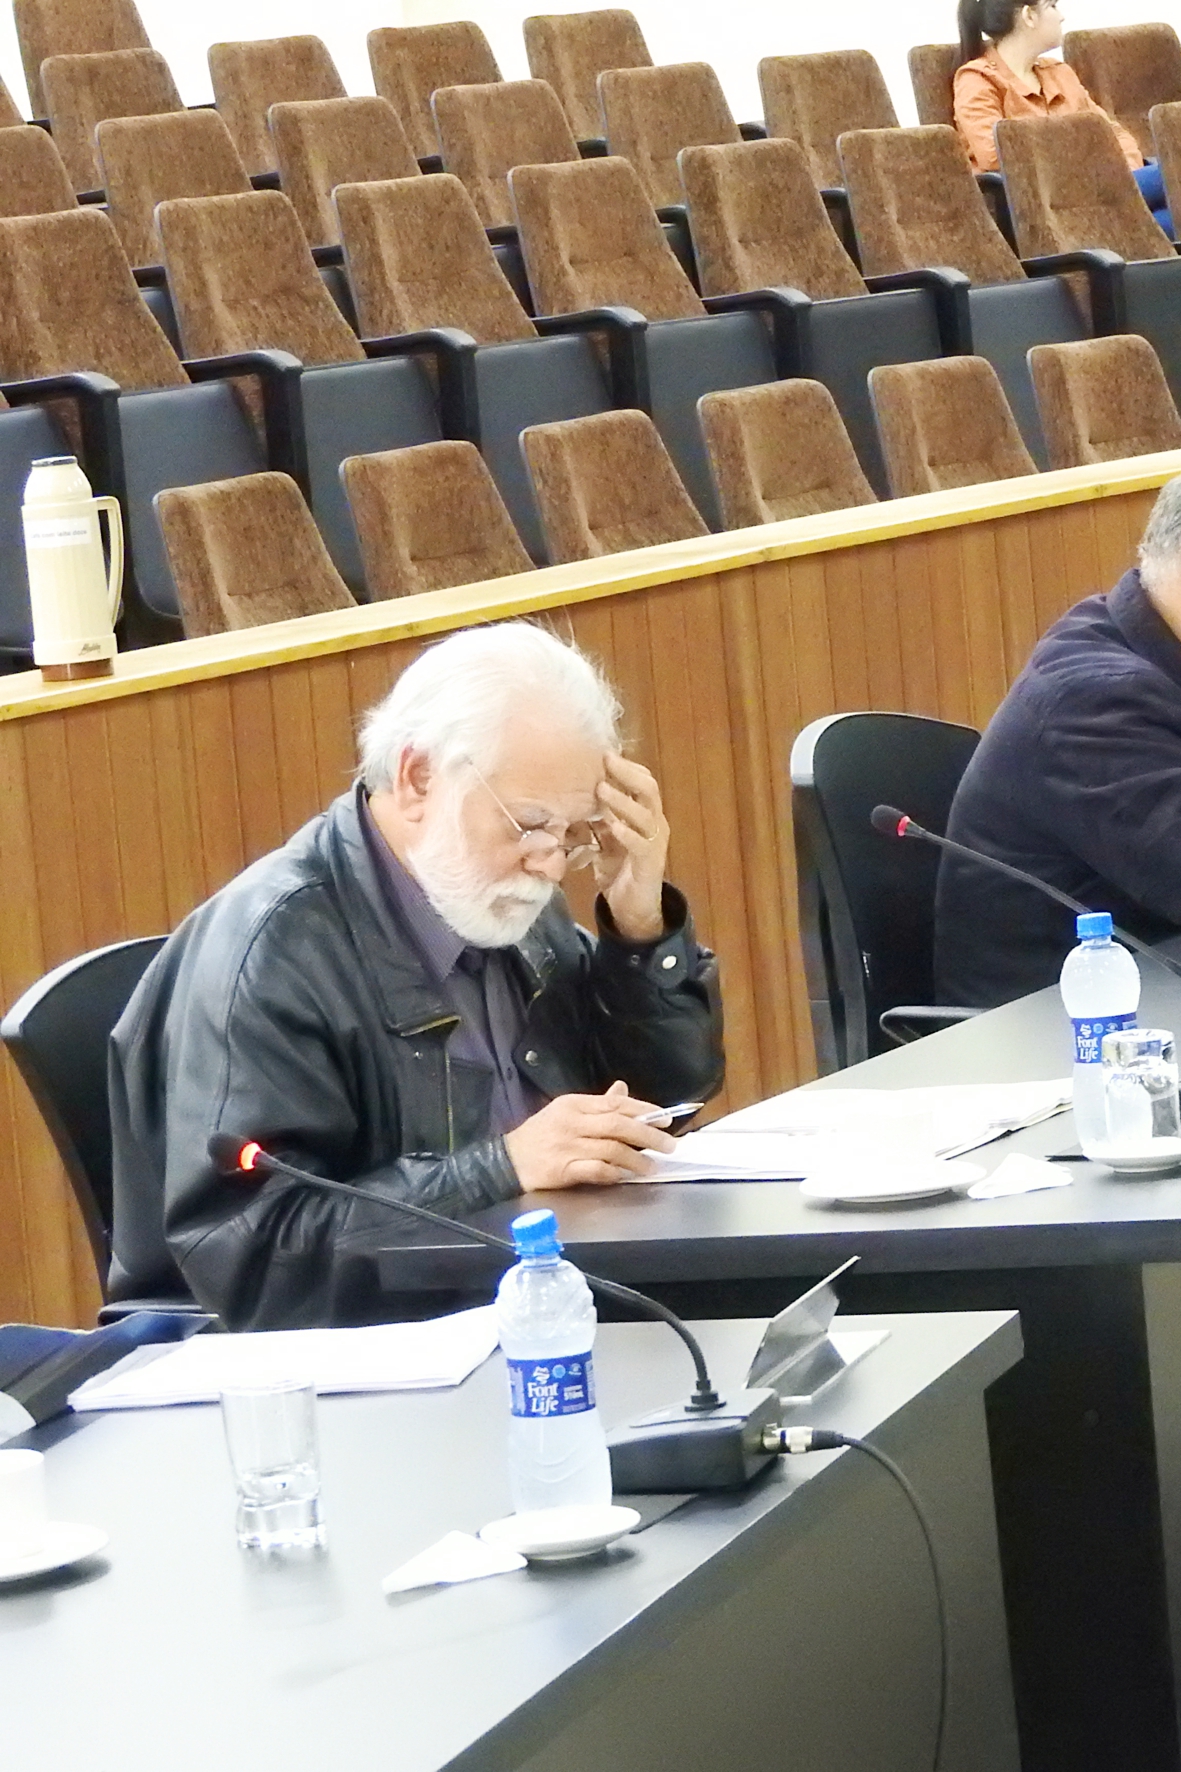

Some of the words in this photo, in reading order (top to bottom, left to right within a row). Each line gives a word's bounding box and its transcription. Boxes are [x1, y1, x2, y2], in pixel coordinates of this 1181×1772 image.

[1077, 1036, 1098, 1048] Font
[1080, 1048, 1099, 1062] Life
[527, 1382, 559, 1398] Font
[531, 1397, 559, 1416] Life
